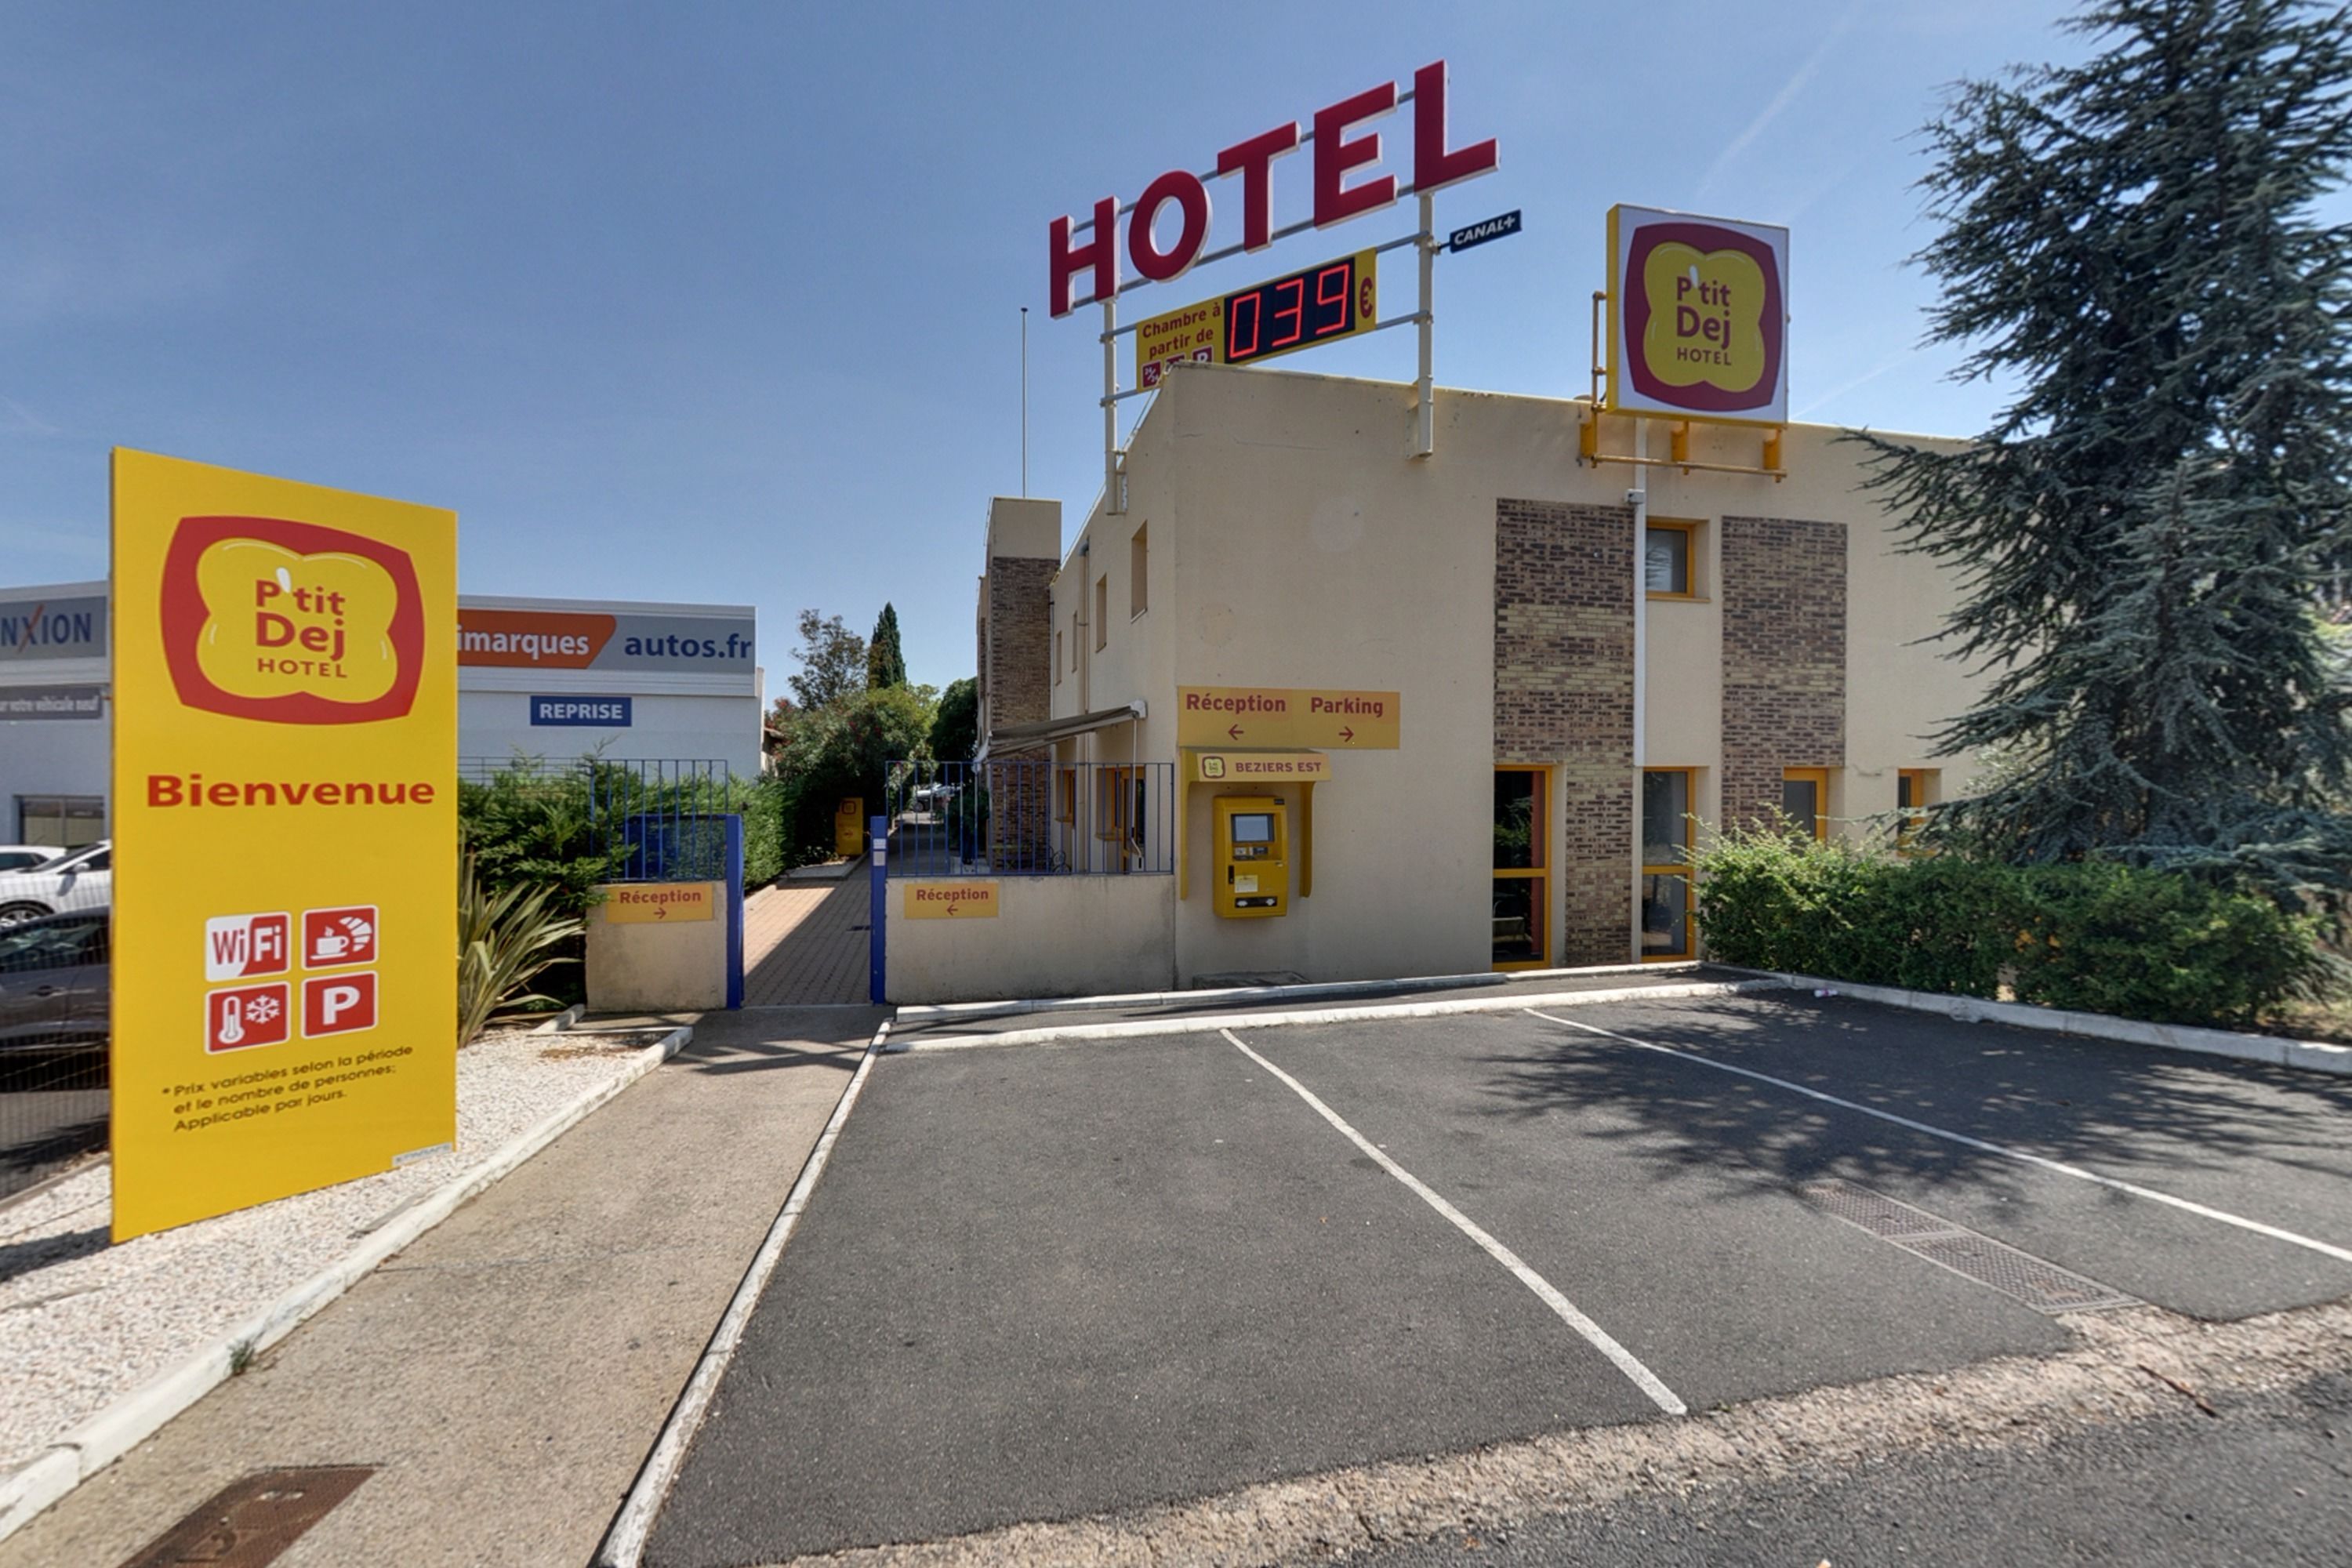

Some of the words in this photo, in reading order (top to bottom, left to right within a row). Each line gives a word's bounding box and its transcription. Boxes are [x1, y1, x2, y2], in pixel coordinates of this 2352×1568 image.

[1050, 59, 1500, 318] HOTEL
[1454, 216, 1515, 245] CANAL+
[1142, 310, 1207, 338] Chambre
[1213, 302, 1221, 318] à
[1229, 263, 1350, 358] 039
[1359, 276, 1373, 319] €
[1149, 334, 1191, 360] partir
[1196, 328, 1214, 343] de
[1676, 305, 1731, 350] Dej
[1677, 347, 1732, 365] HOTEL
[256, 611, 344, 662] Dej
[624, 633, 753, 659] autos.fr
[257, 658, 347, 678] HOTEL
[539, 703, 623, 720] REPRISE
[1186, 693, 1287, 714] Réception
[1311, 697, 1383, 717] Parking
[1236, 762, 1293, 772] BEZIERS
[1298, 762, 1321, 772] EST
[147, 773, 435, 808] Bienvenue
[619, 890, 702, 905] Réception
[916, 888, 989, 902] Réception
[212, 925, 281, 965] WiFi
[323, 985, 361, 1025] P
[211, 1069, 288, 1088] variables
[292, 1060, 334, 1075] selon
[339, 1056, 352, 1066] la
[356, 1046, 413, 1064] période
[174, 1102, 191, 1113] et
[197, 1099, 212, 1109] le
[218, 1086, 284, 1105] nombre
[289, 1080, 310, 1092] de
[174, 1105, 270, 1131] Applicable
[275, 1098, 302, 1112] par
